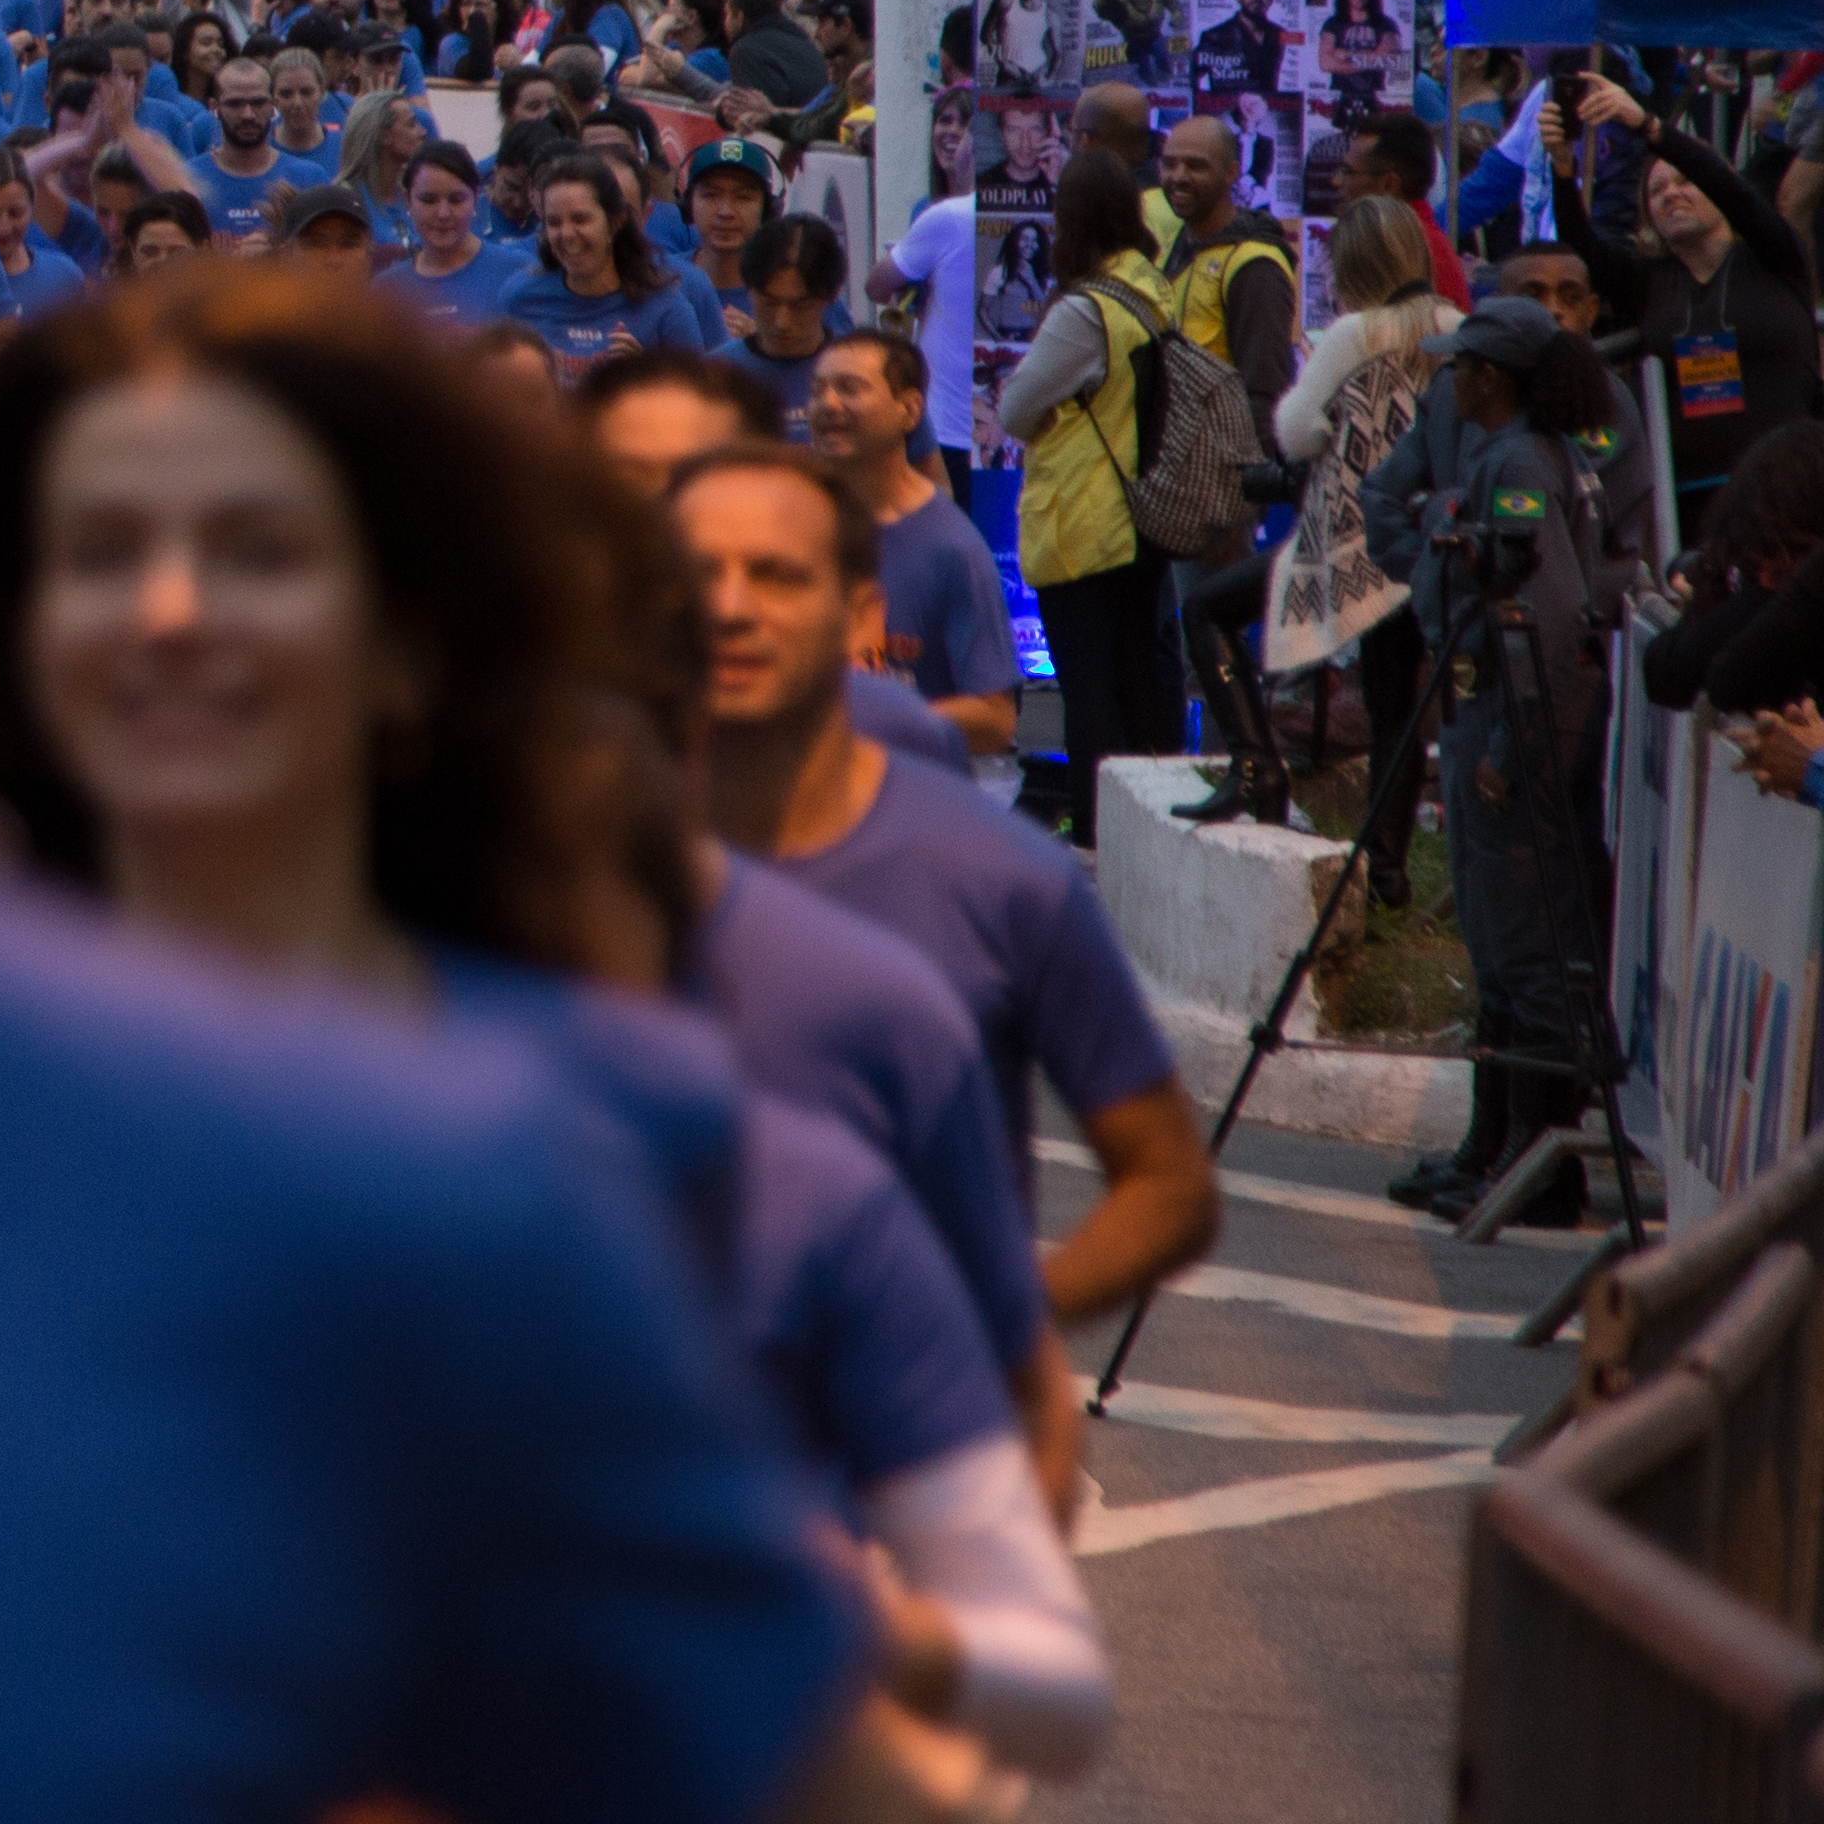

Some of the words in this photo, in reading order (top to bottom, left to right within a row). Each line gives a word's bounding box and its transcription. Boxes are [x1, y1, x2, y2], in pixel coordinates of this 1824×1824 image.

[1085, 43, 1128, 70] HULK
[1196, 51, 1244, 67] Ringo
[1212, 67, 1250, 82] Starr
[228, 208, 261, 218] CAIXA
